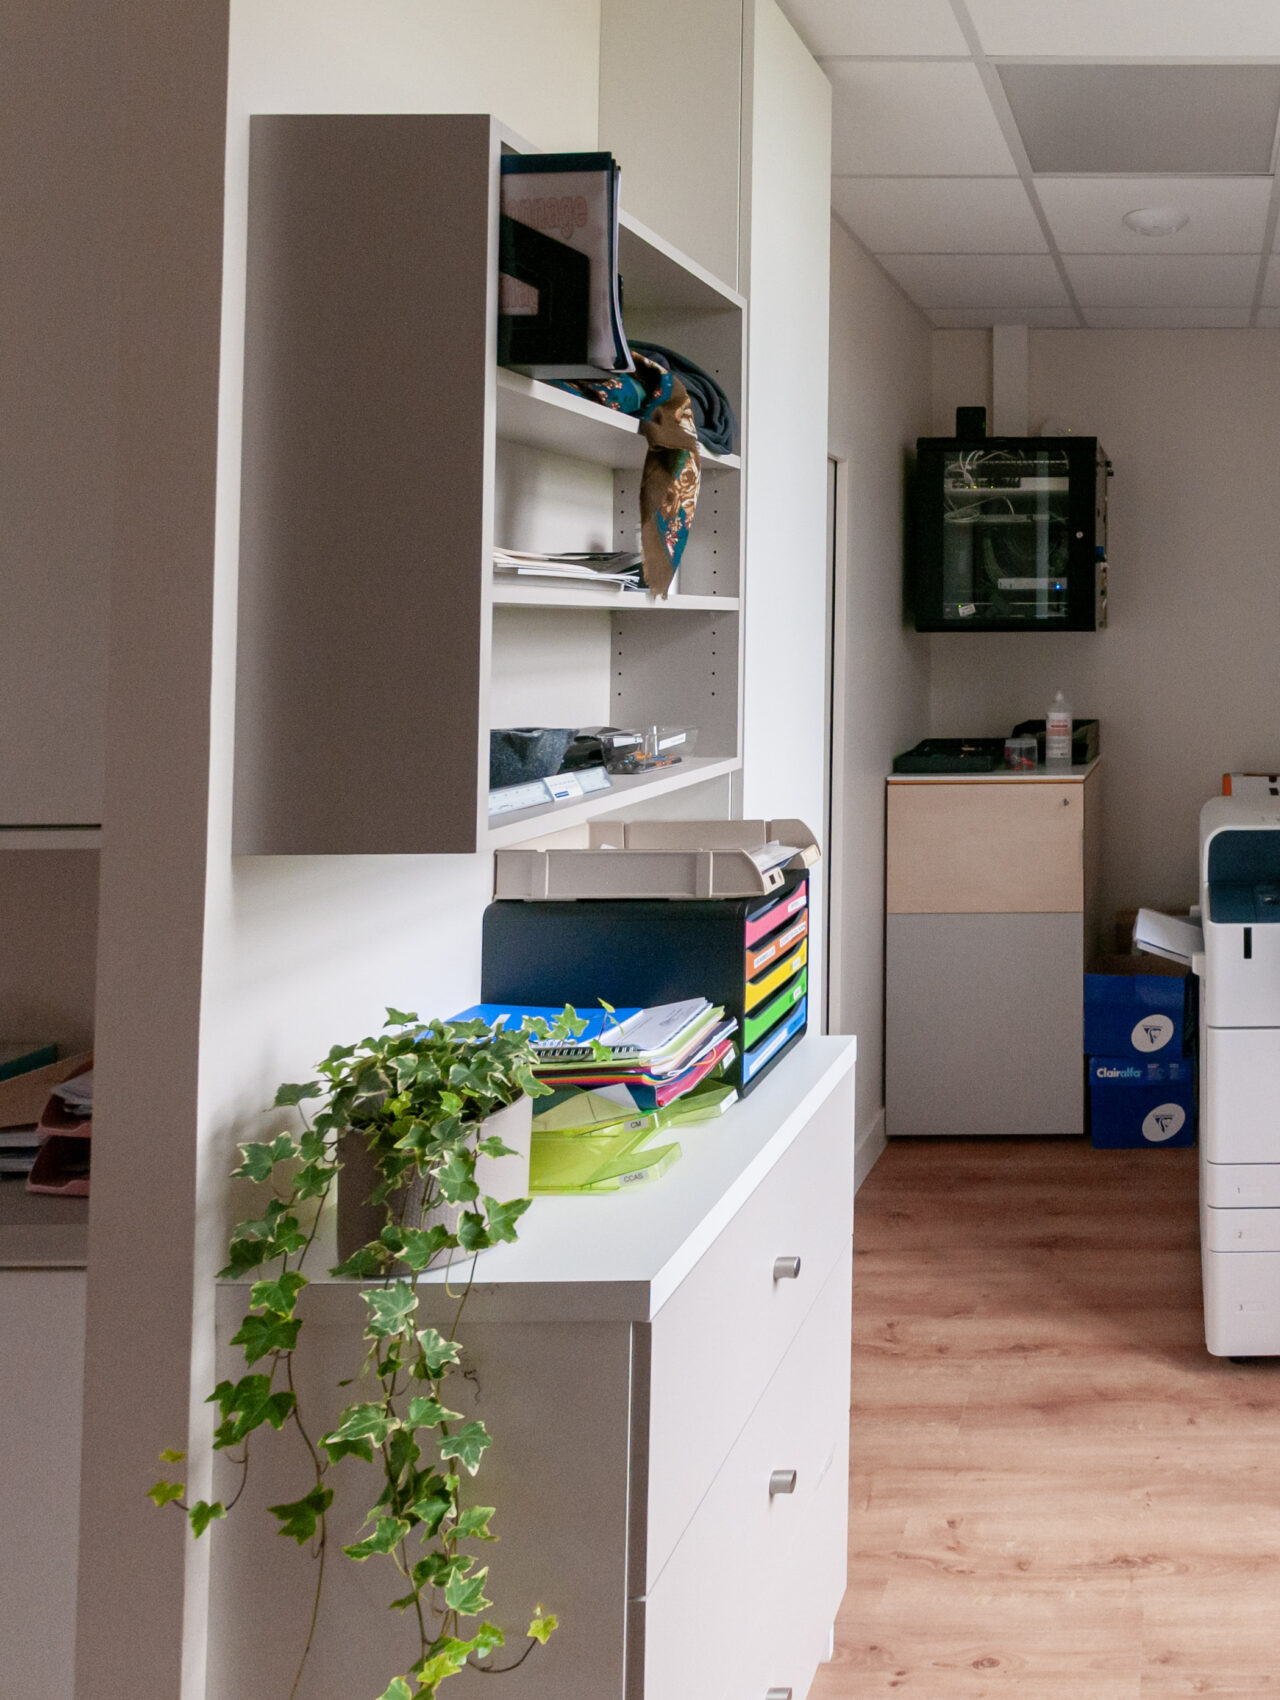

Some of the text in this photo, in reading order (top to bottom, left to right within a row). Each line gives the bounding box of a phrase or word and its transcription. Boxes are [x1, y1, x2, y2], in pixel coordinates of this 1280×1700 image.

[1096, 1067, 1141, 1078] Clairalfa
[630, 1120, 642, 1129] CM
[623, 1173, 644, 1183] CCAS
